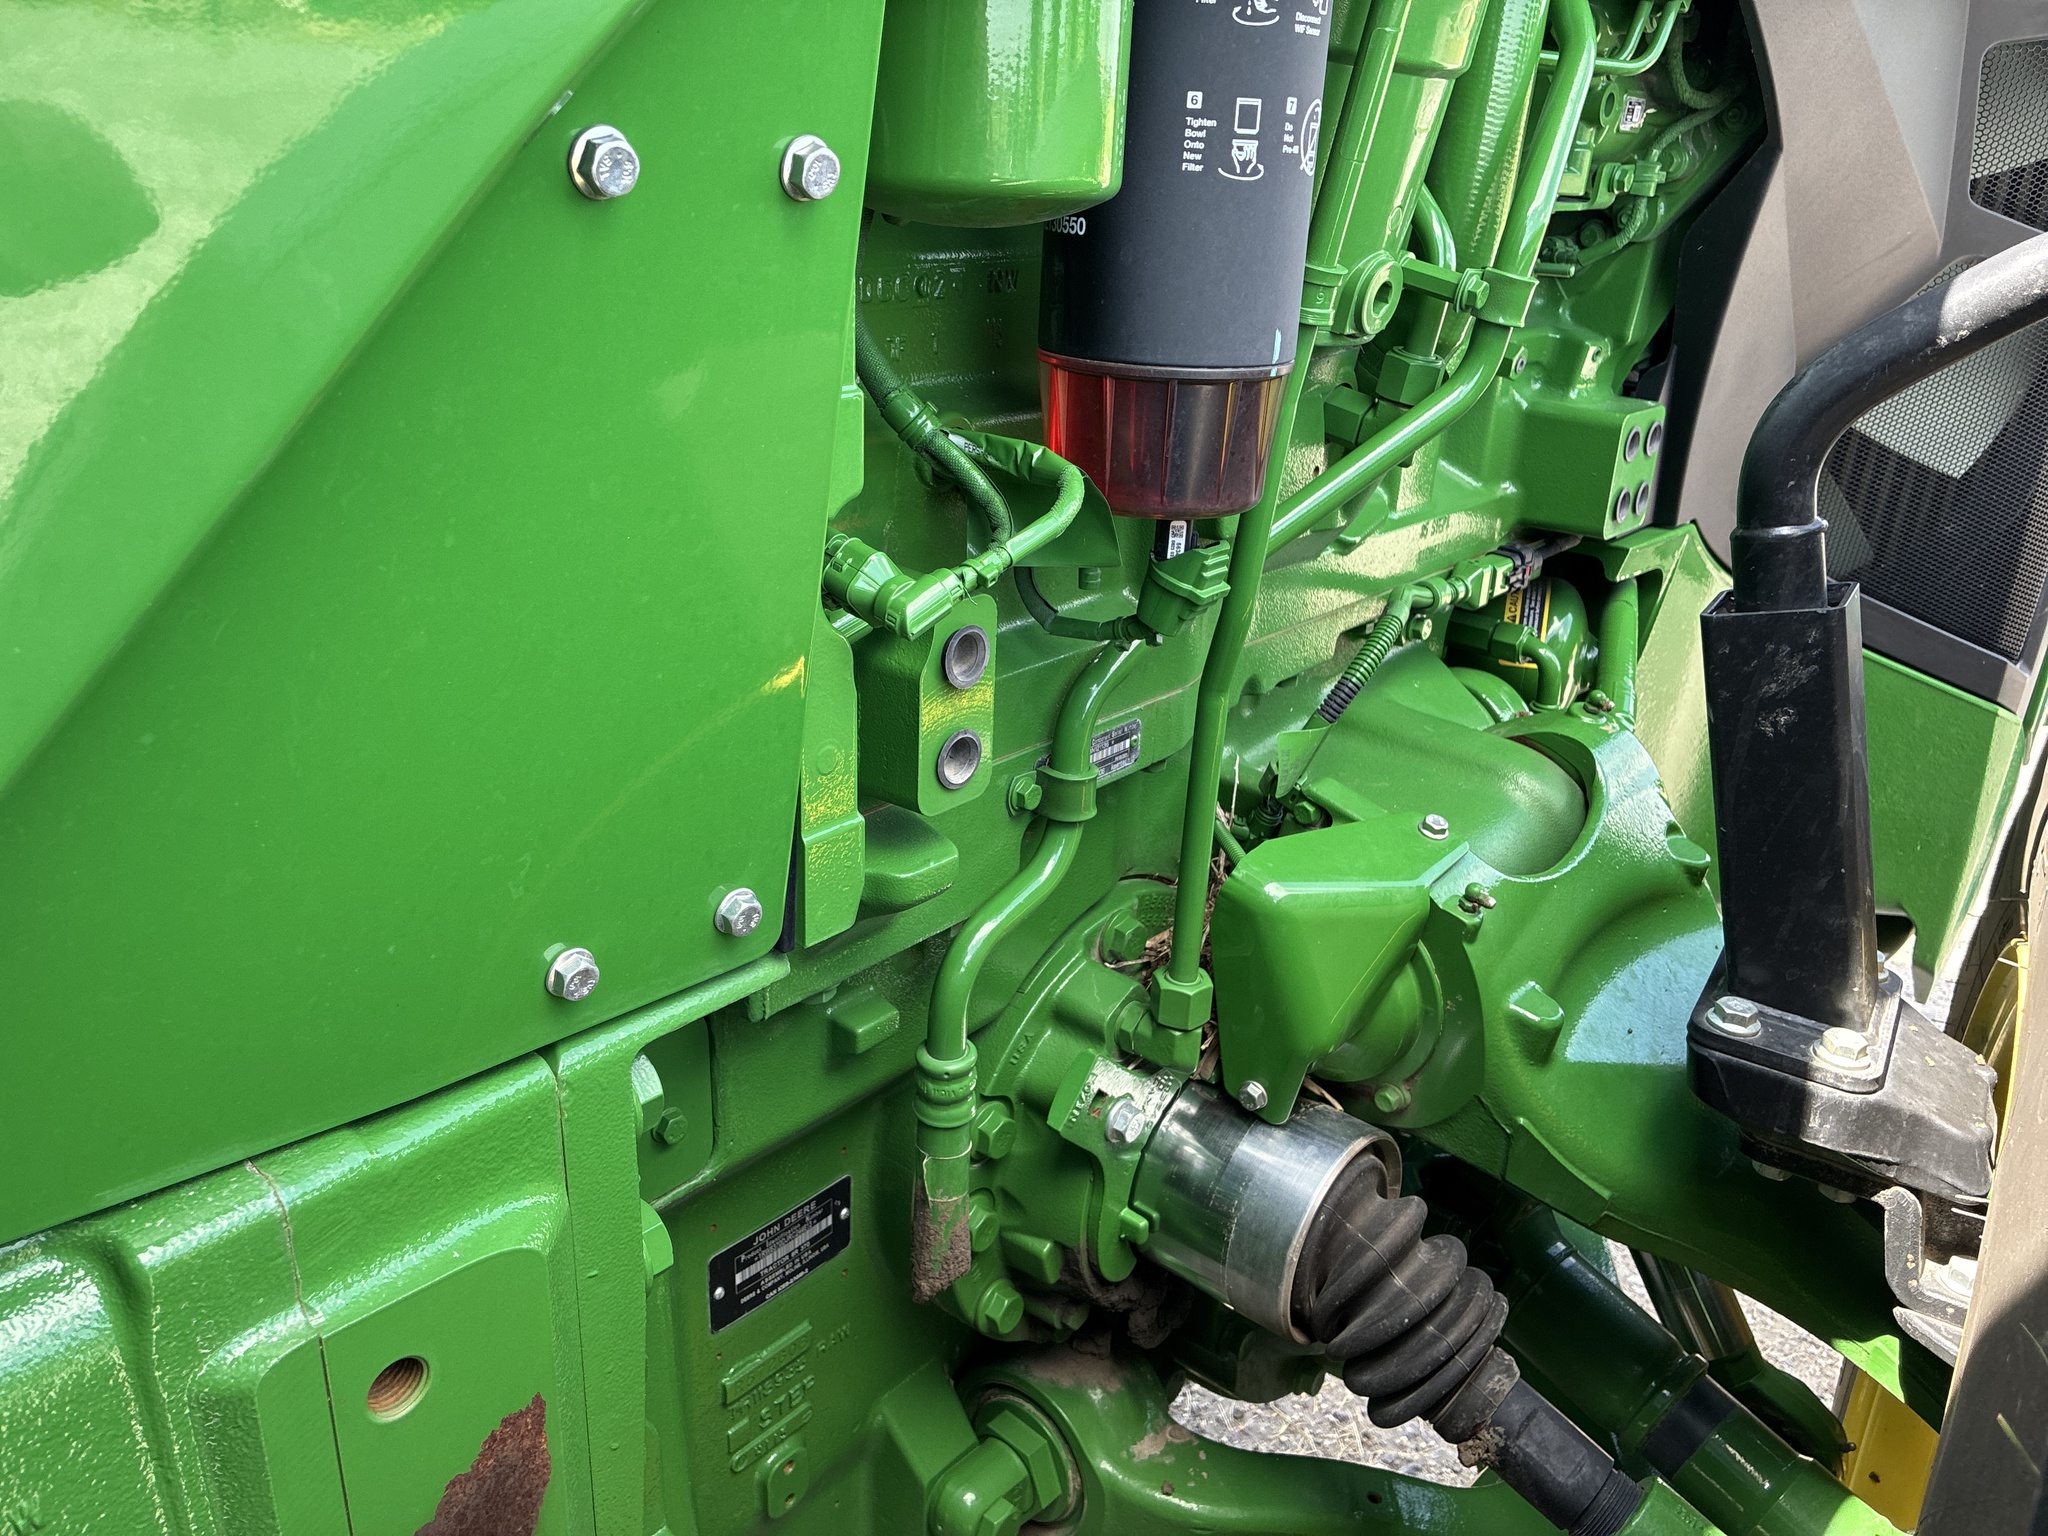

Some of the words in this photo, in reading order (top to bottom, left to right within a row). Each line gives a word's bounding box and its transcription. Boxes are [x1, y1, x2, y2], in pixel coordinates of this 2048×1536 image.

[1296, 12, 1321, 24] Disconnect
[1306, 25, 1320, 36] Sensor
[1186, 116, 1217, 128] Tighten
[1284, 122, 1294, 132] Do
[1184, 128, 1206, 138] Bowl
[1284, 134, 1294, 142] Not
[1184, 140, 1204, 149] Onto
[1182, 151, 1202, 160] New
[1182, 162, 1204, 172] Filter
[752, 1223, 781, 1246] JOHN
[784, 1200, 817, 1227] DEERE
[760, 1254, 790, 1276] TRACTOR
